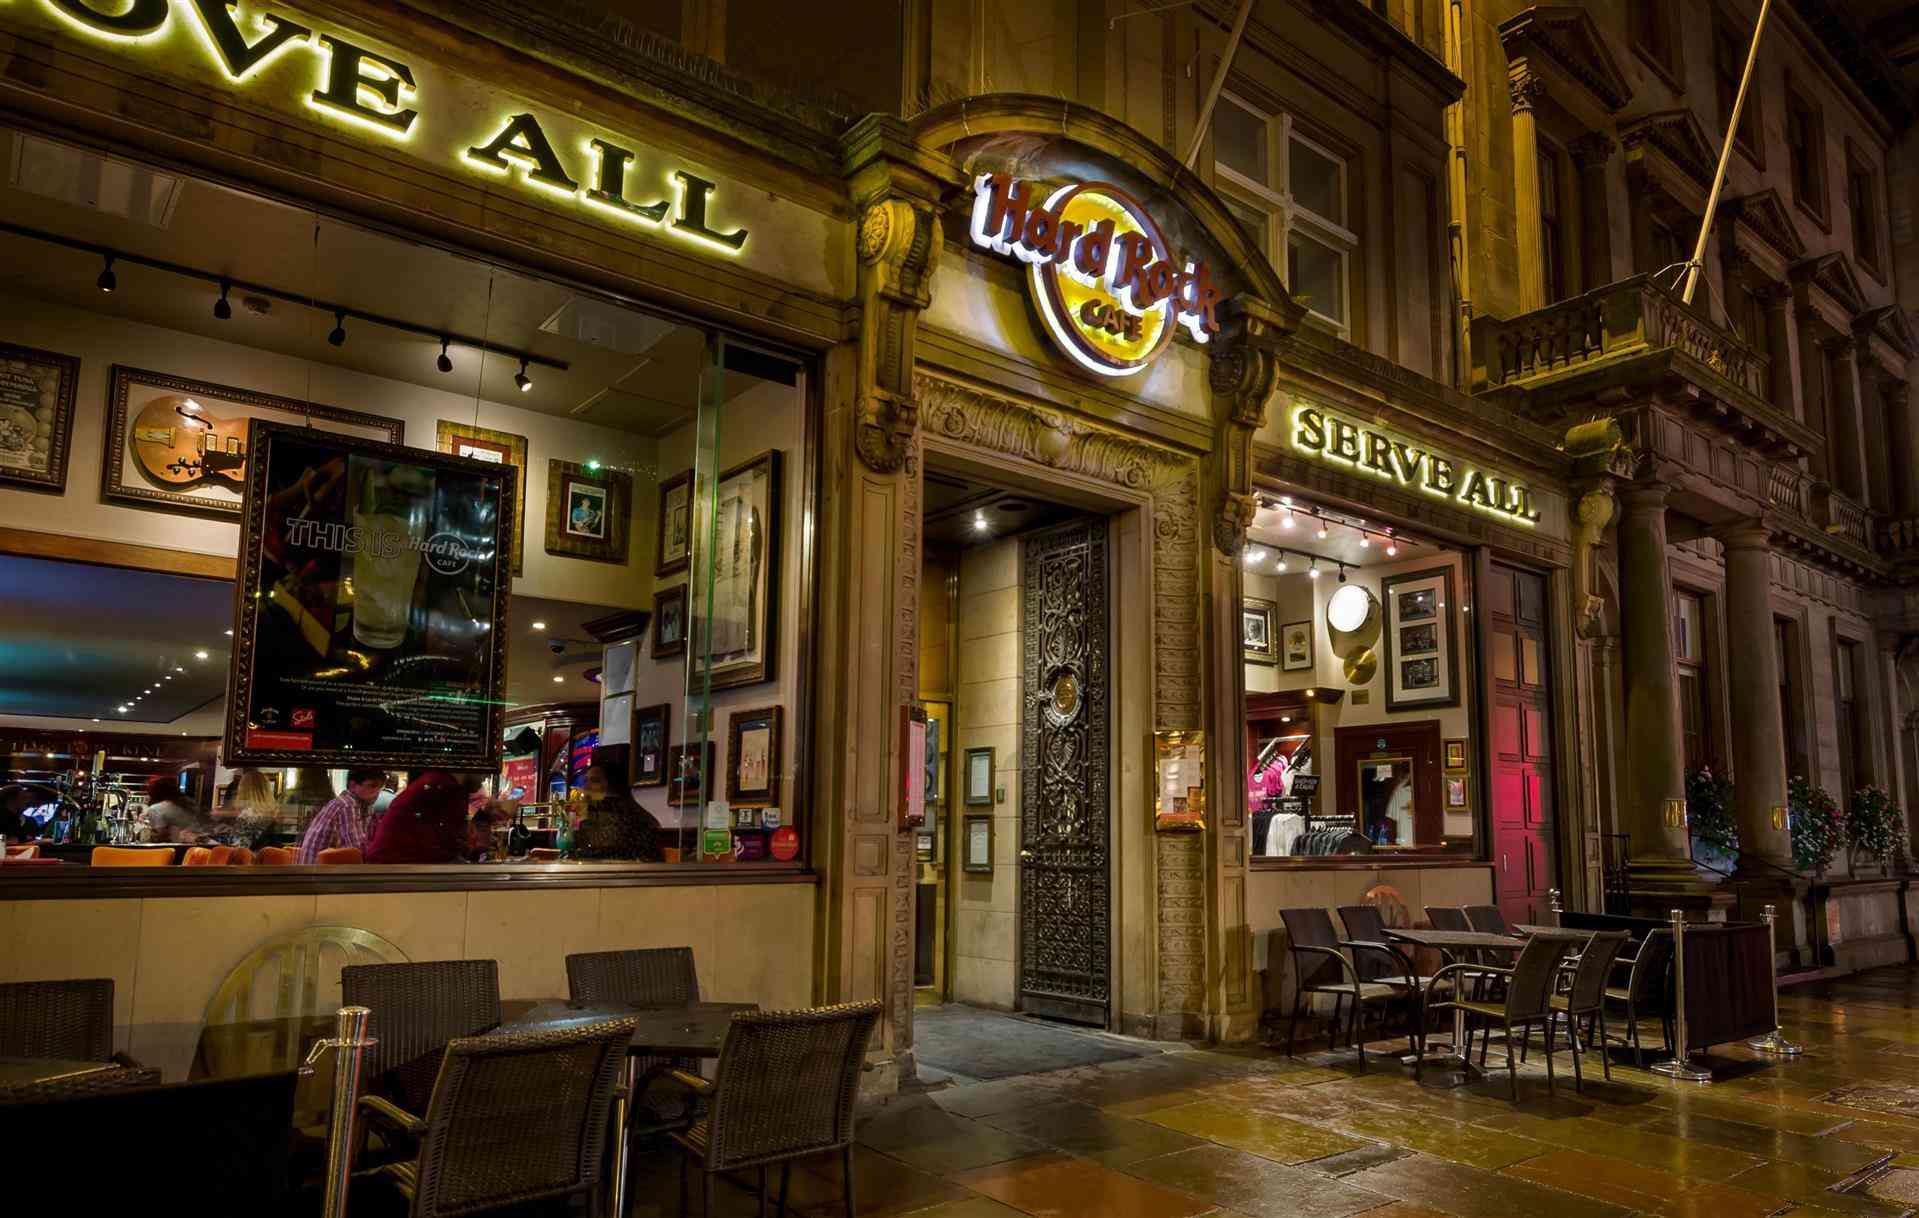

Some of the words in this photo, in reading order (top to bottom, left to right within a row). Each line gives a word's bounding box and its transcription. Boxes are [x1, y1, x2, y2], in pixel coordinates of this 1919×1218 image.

[465, 112, 749, 251] ALL
[974, 172, 1117, 280] Hard
[1107, 230, 1221, 338] Rock
[1080, 299, 1144, 342] CAFE
[1295, 407, 1457, 496] SERVE
[1459, 470, 1541, 524] ALL
[285, 517, 363, 553] THIS
